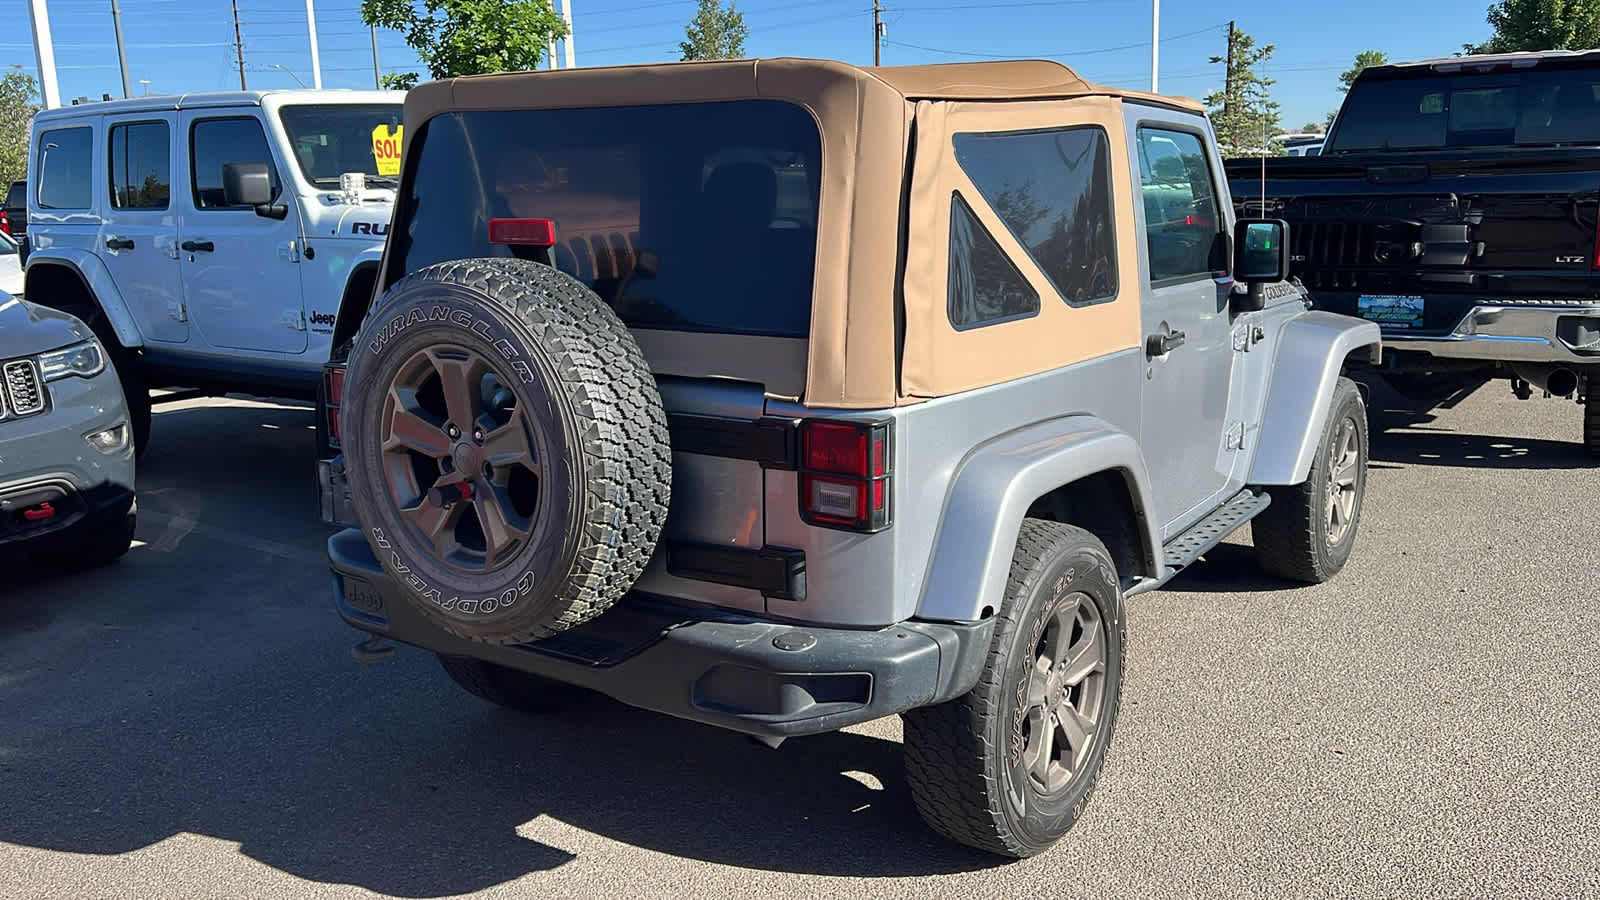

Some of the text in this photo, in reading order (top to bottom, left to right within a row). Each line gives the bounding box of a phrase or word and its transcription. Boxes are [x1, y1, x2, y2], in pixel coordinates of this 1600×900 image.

[375, 139, 400, 158] SOL
[352, 223, 390, 234] RU
[310, 310, 335, 326] Jeep
[369, 305, 535, 385] WRANGLER
[372, 527, 536, 615] GOODYEAR
